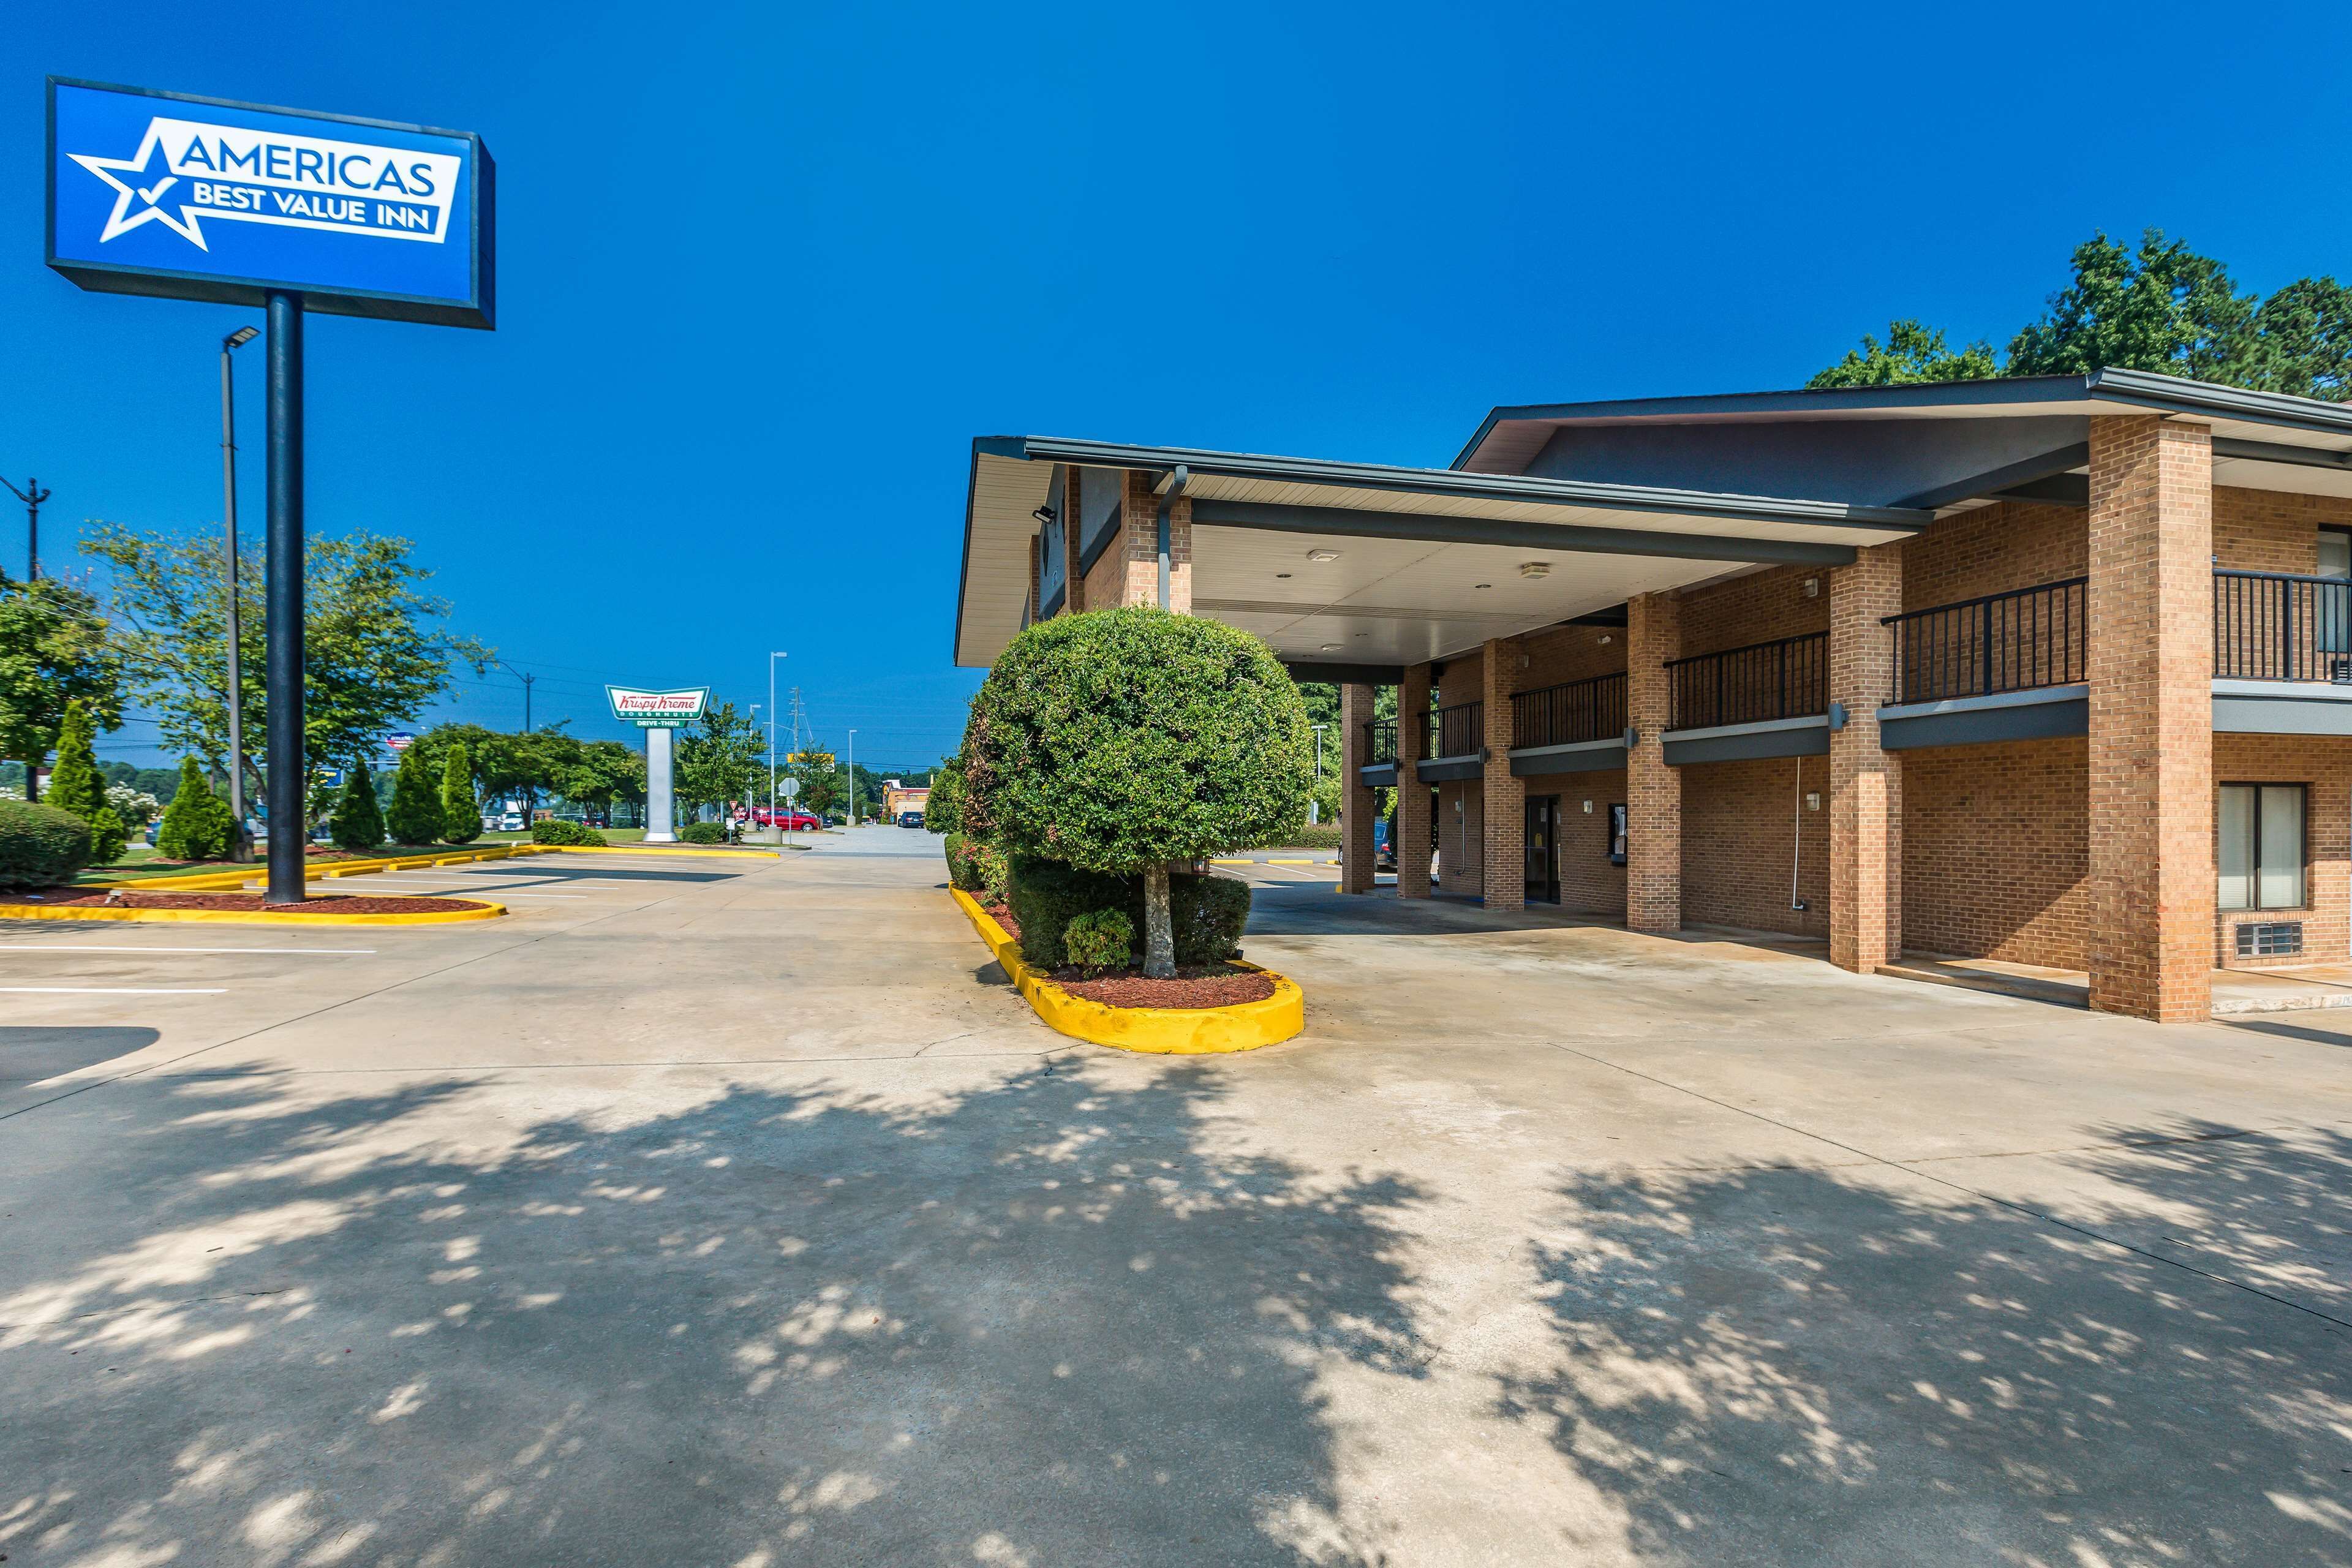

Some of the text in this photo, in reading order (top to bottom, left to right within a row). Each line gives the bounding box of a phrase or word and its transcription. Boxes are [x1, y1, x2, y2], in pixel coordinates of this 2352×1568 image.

[178, 134, 435, 197] AMERICAS
[194, 182, 429, 230] BEST VALUE INN
[619, 696, 696, 710] Krispy Kreme
